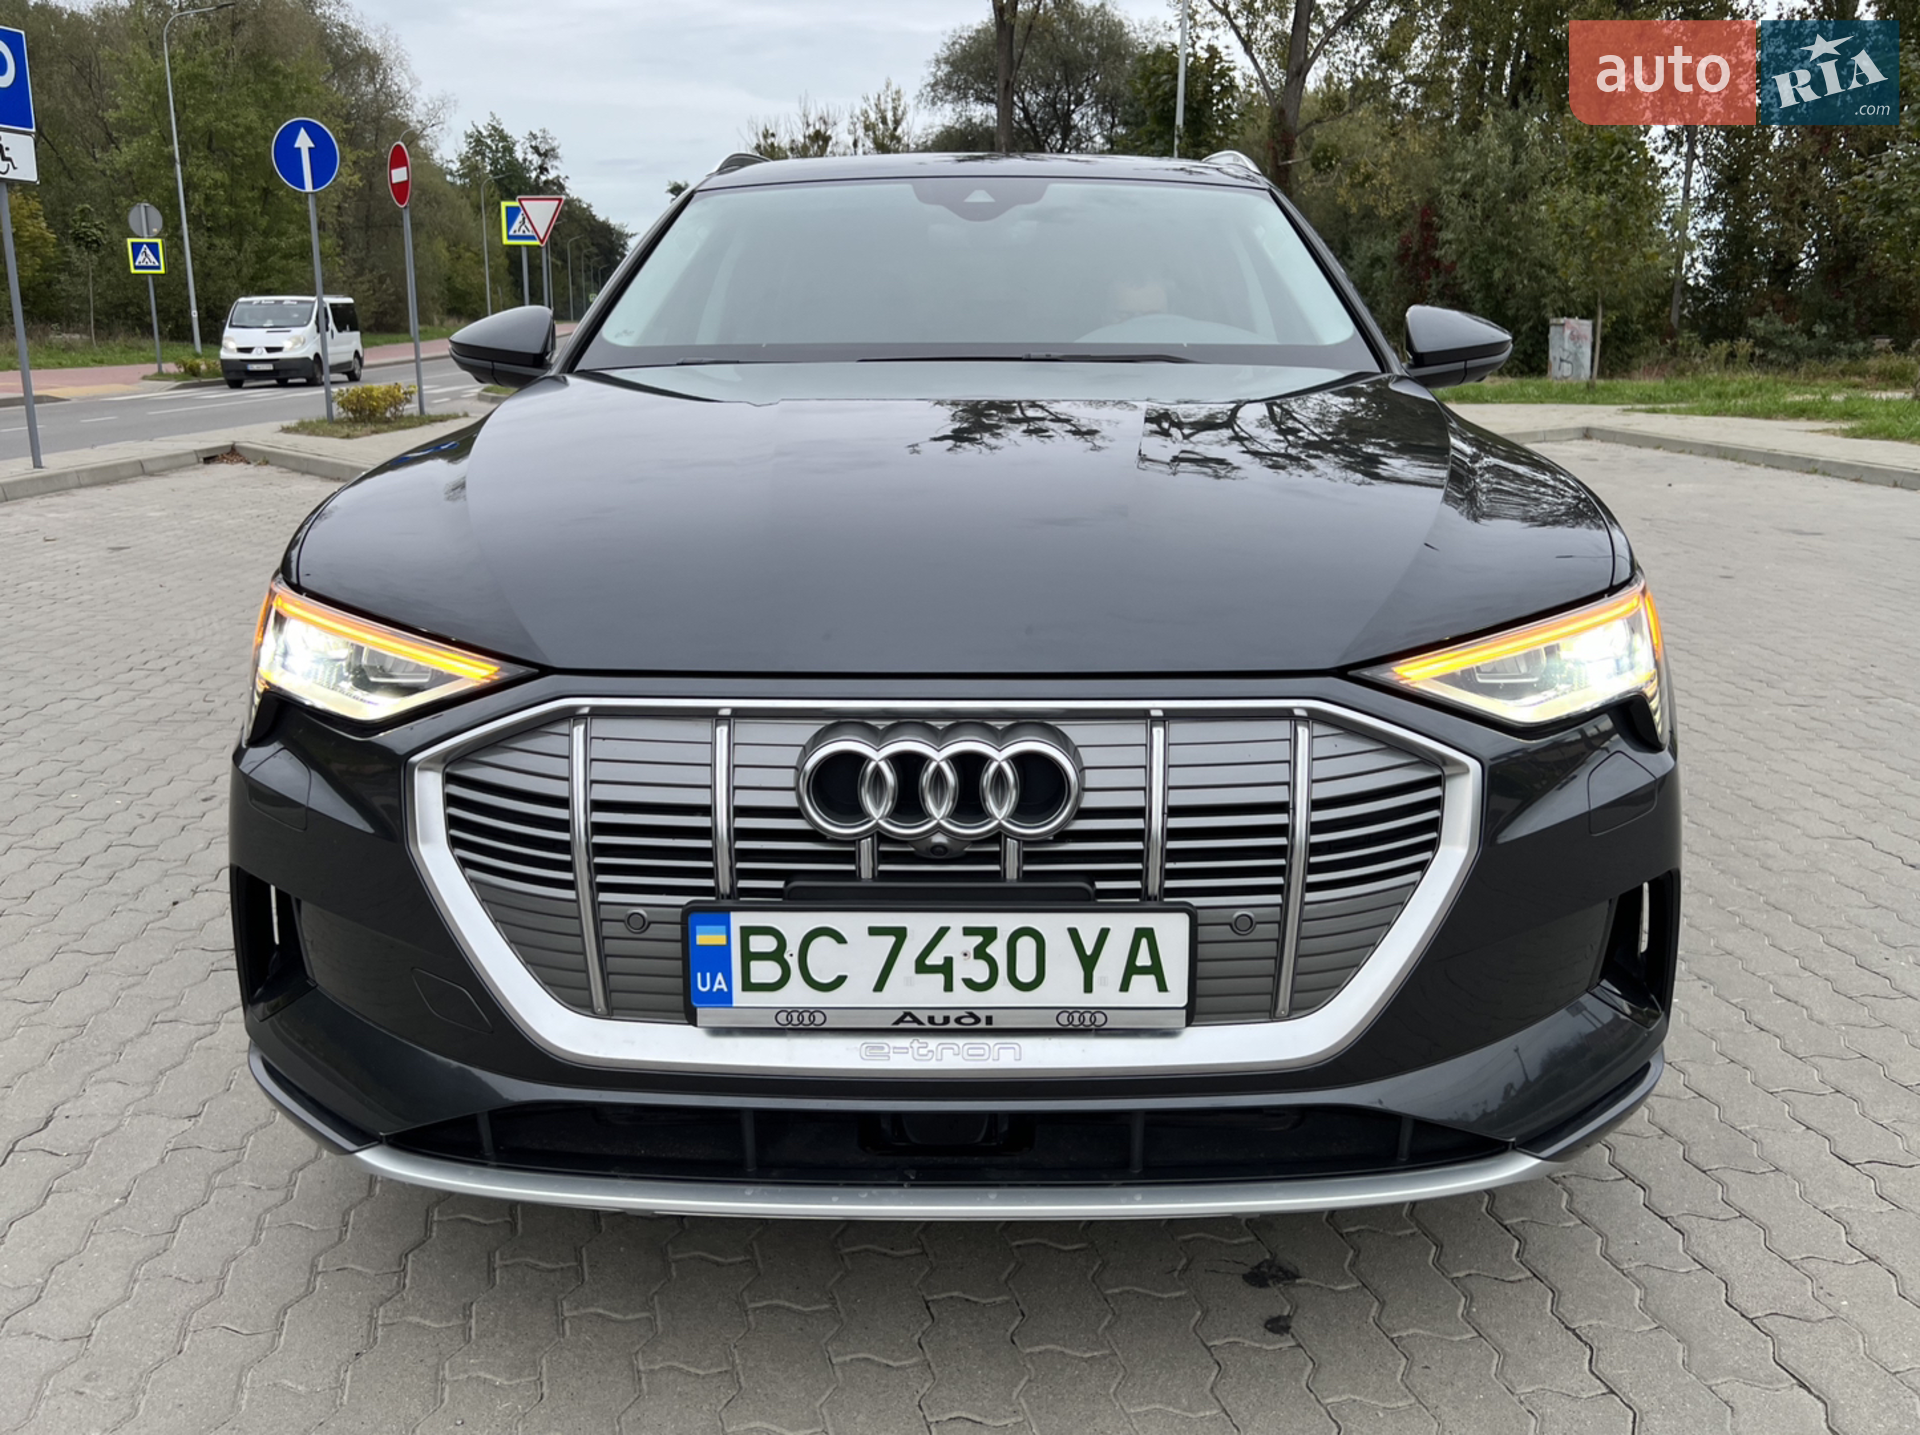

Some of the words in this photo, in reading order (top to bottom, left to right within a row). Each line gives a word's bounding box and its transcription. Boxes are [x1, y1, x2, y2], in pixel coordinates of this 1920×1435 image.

[739, 926, 848, 992] BC
[868, 926, 1046, 992] 7430
[1067, 927, 1169, 993] YA
[697, 972, 728, 992] UA
[891, 1011, 993, 1026] Audi
[860, 1038, 1021, 1061] e-tron
